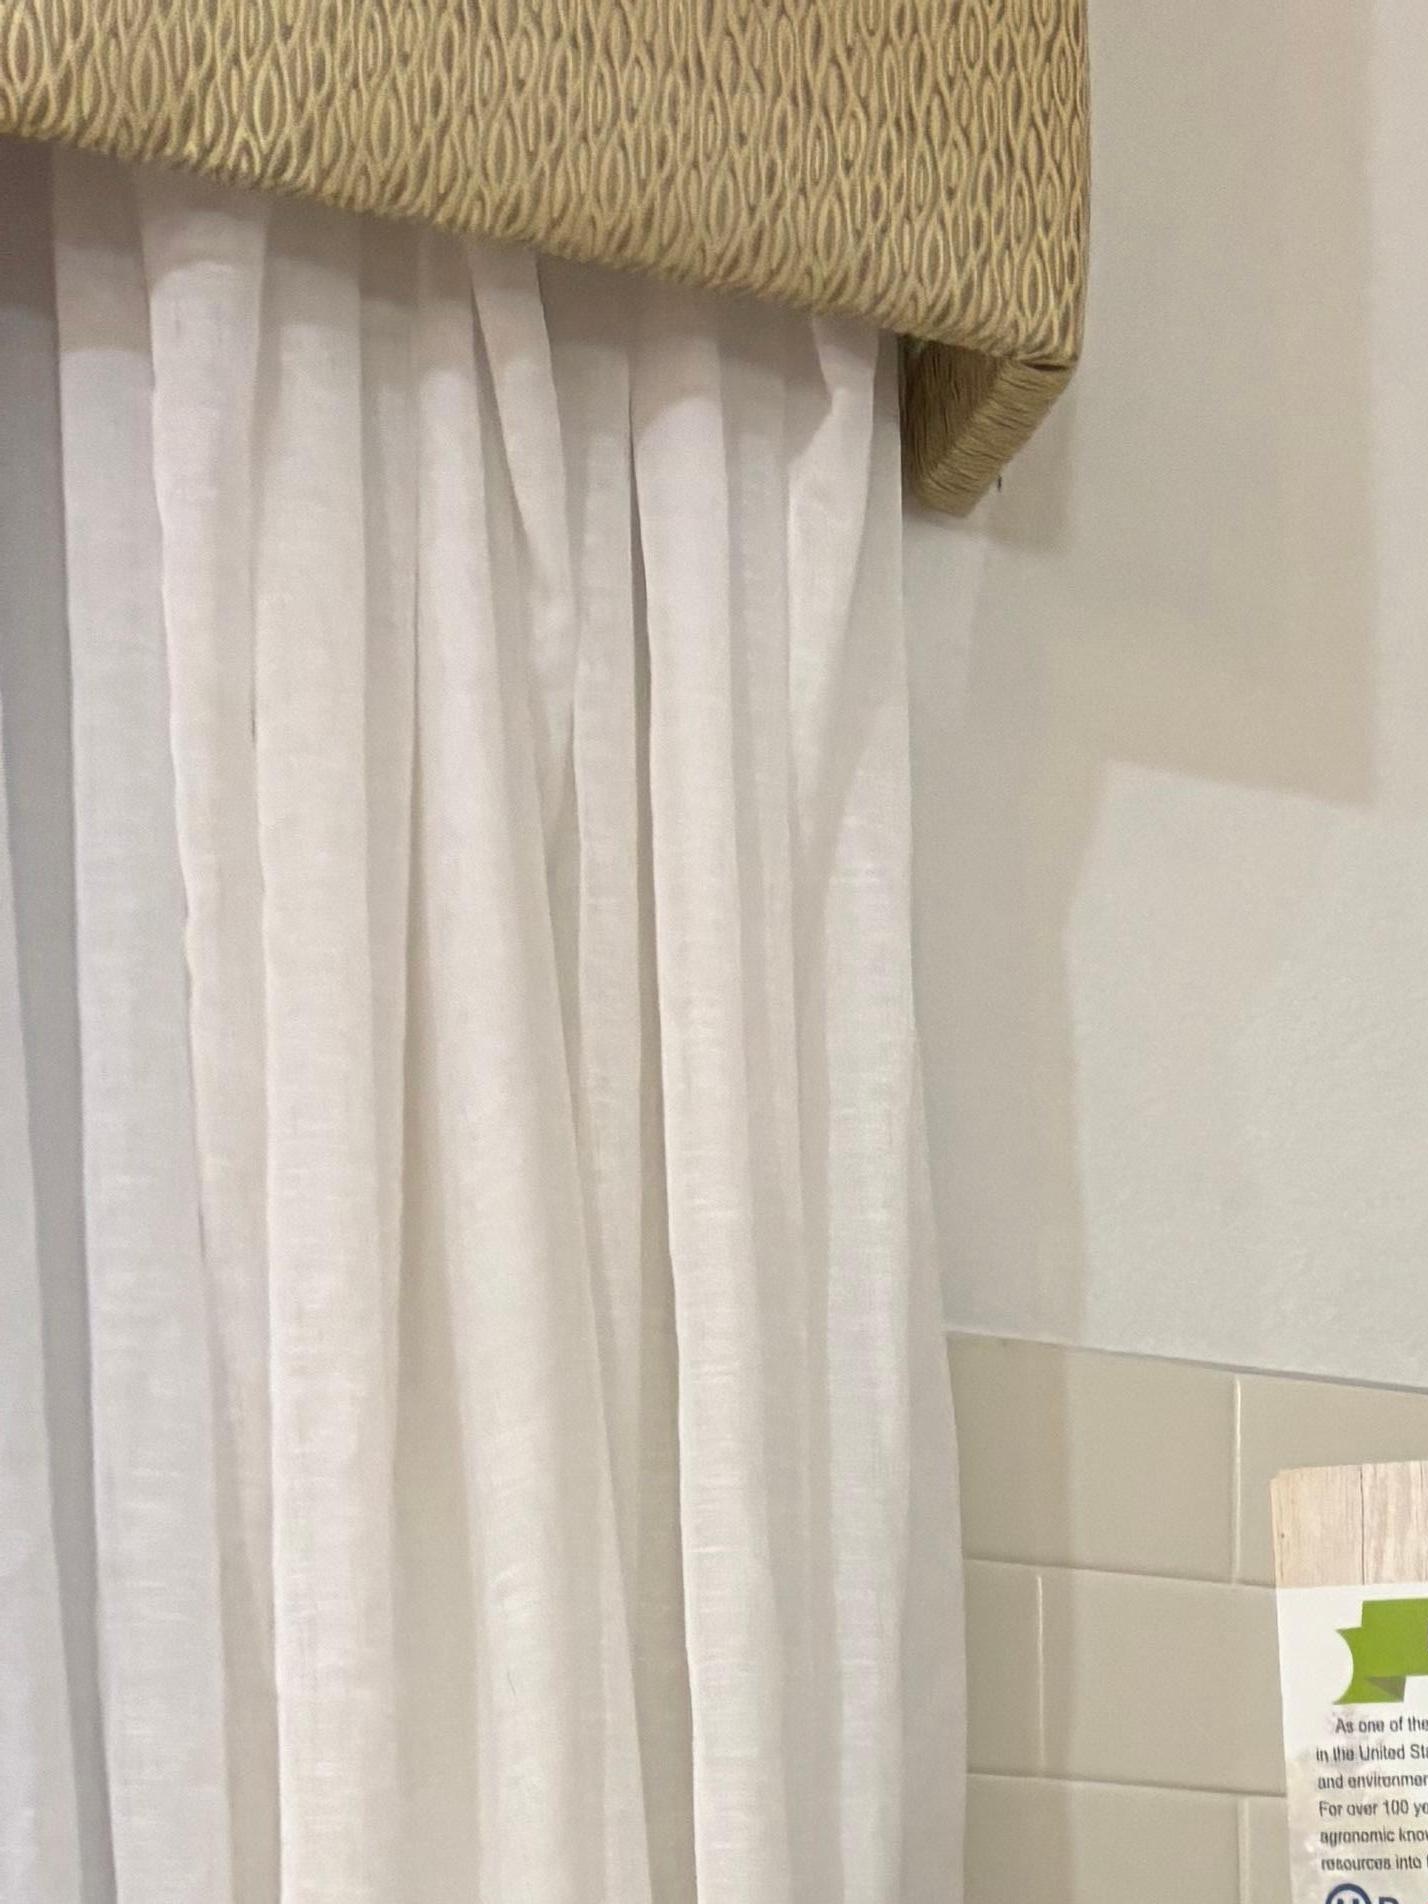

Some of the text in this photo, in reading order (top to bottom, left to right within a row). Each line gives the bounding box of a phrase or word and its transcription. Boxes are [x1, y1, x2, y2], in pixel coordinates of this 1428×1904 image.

[1335, 1718, 1354, 1734] As
[1359, 1719, 1384, 1733] one
[1390, 1717, 1403, 1732] of
[1316, 1745, 1328, 1762] in
[1333, 1745, 1354, 1761] the
[1359, 1745, 1405, 1760] United
[1318, 1774, 1343, 1789] and
[1319, 1801, 1343, 1816] For
[1347, 1803, 1378, 1816] over
[1384, 1799, 1409, 1814] 100
[1320, 1829, 1395, 1846] agronomic
[1321, 1857, 1391, 1871] resources
[1396, 1854, 1422, 1869] into
